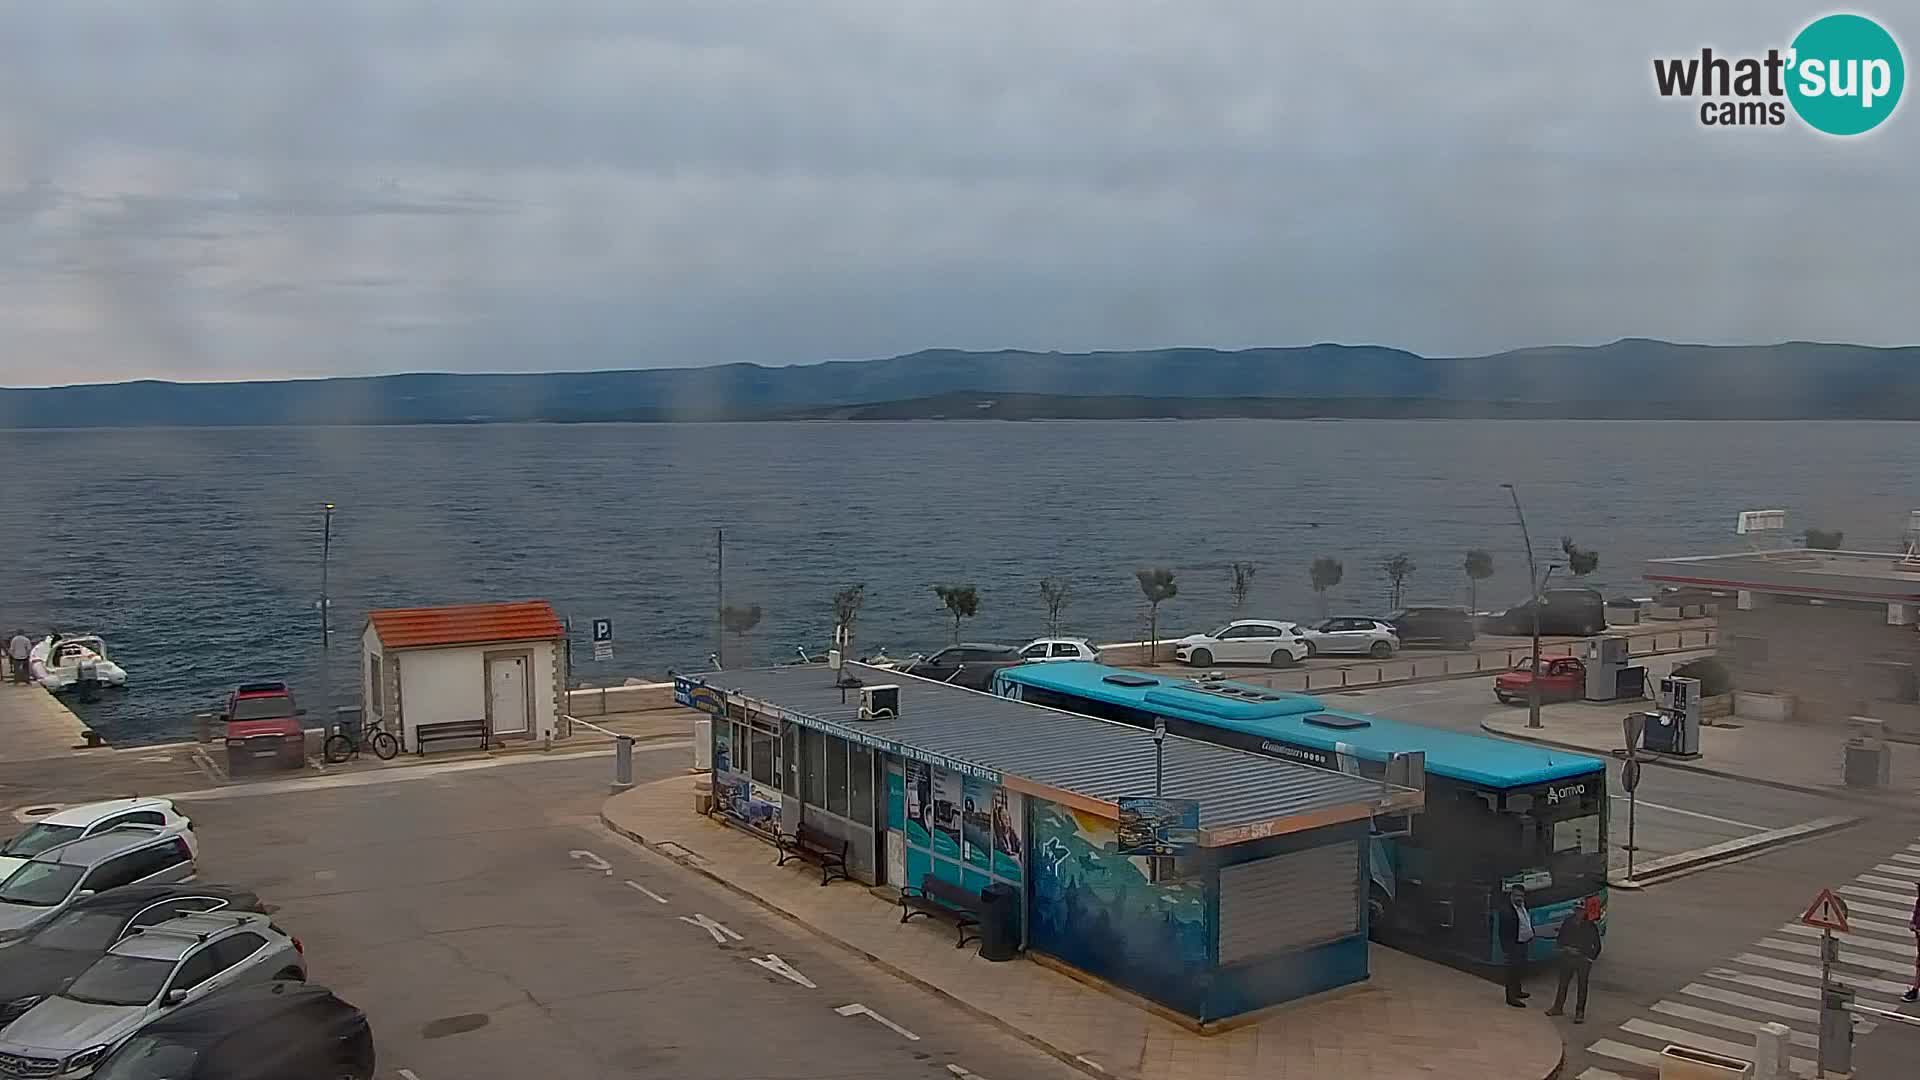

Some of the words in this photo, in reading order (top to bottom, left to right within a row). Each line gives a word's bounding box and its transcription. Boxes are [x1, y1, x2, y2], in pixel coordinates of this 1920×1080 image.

[597, 621, 608, 638] P
[900, 746, 914, 758] BUS
[915, 750, 945, 767] STATION
[947, 759, 972, 774] TICKET
[973, 768, 998, 782] OFFICE
